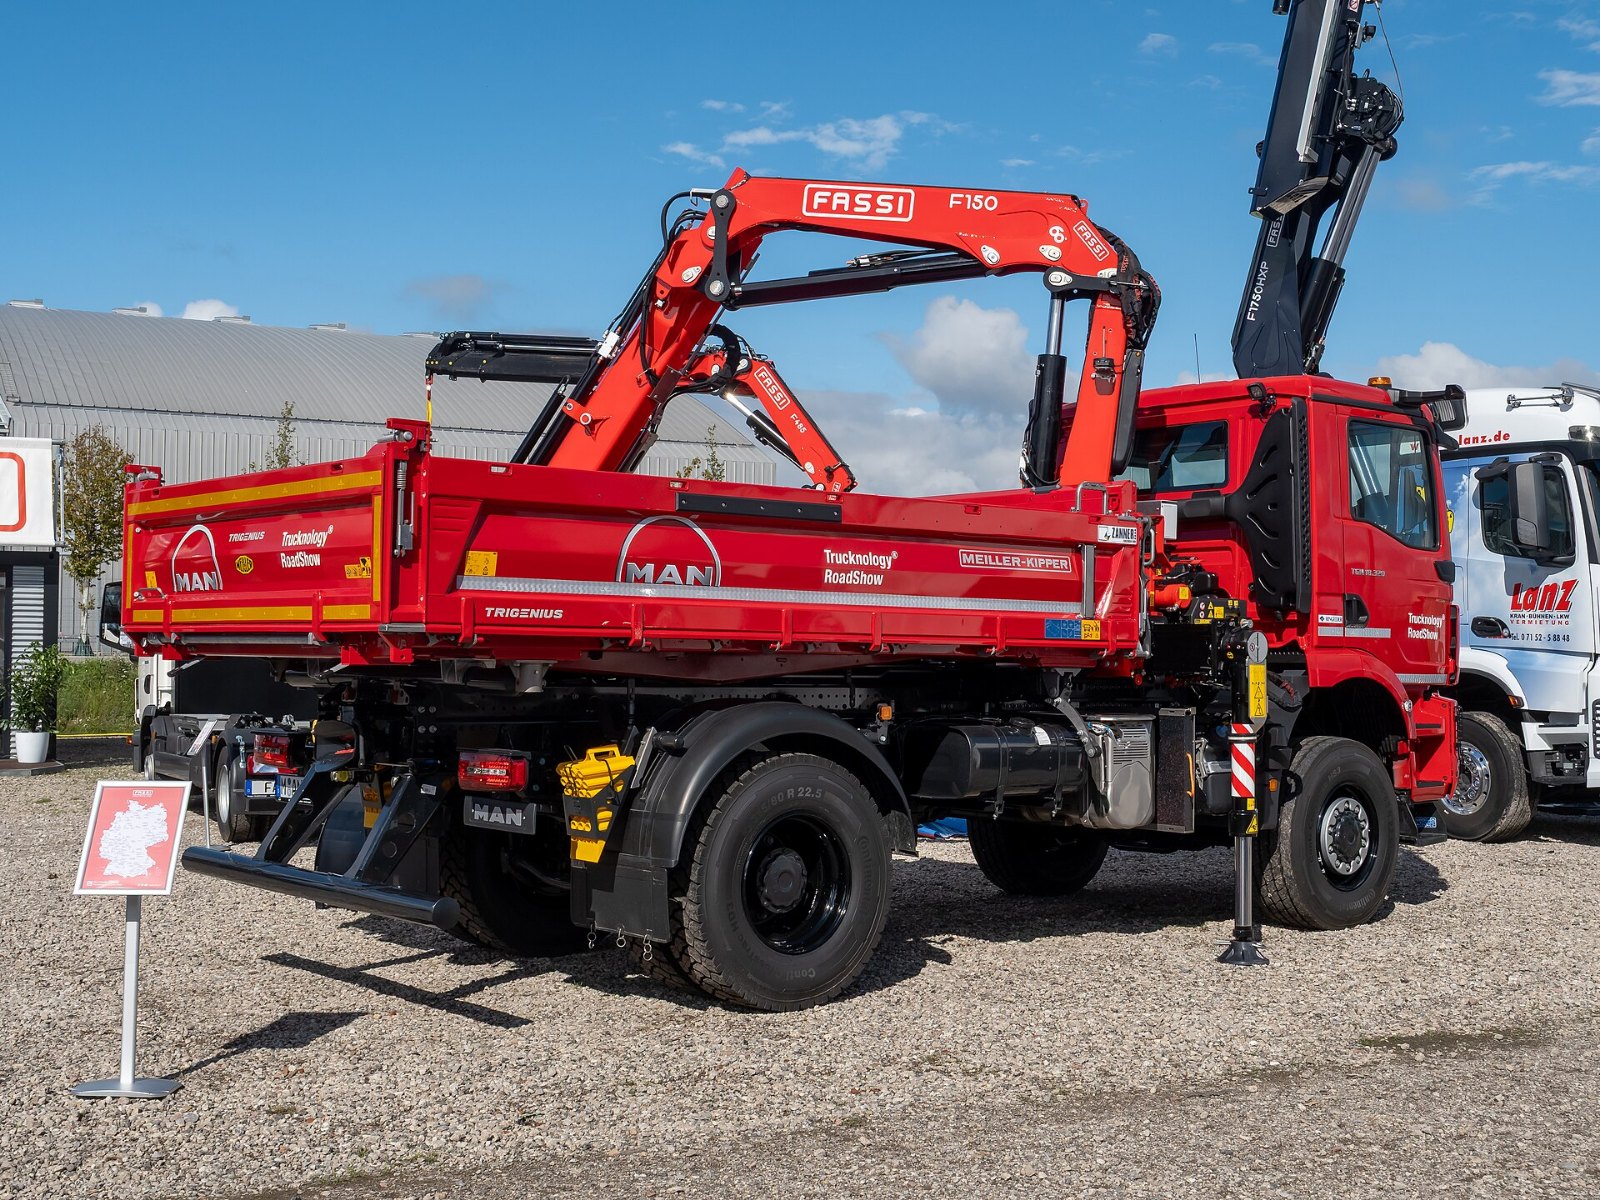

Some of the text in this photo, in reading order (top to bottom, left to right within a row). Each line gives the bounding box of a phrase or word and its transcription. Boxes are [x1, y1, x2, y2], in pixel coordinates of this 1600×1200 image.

[812, 191, 905, 215] FASSI
[949, 193, 998, 211] F150
[1269, 214, 1283, 244] FAS
[1077, 225, 1106, 258] FASSI
[1246, 261, 1269, 321] F1750HXP
[758, 371, 787, 406] FASSI
[790, 413, 807, 433] F485
[228, 531, 265, 543] TRIGENIUS
[1111, 527, 1134, 540] ZANNER
[280, 551, 321, 569] RoadShow
[961, 553, 1069, 570] MEILLER-KIPPER
[175, 571, 219, 592] MAN
[625, 562, 714, 588] MAN
[824, 569, 884, 586] RoadShow
[485, 607, 564, 619] TRIGENIUS
[1407, 627, 1439, 641] RoadShow
[797, 786, 823, 798] 22.5
[473, 803, 523, 827] MAN
